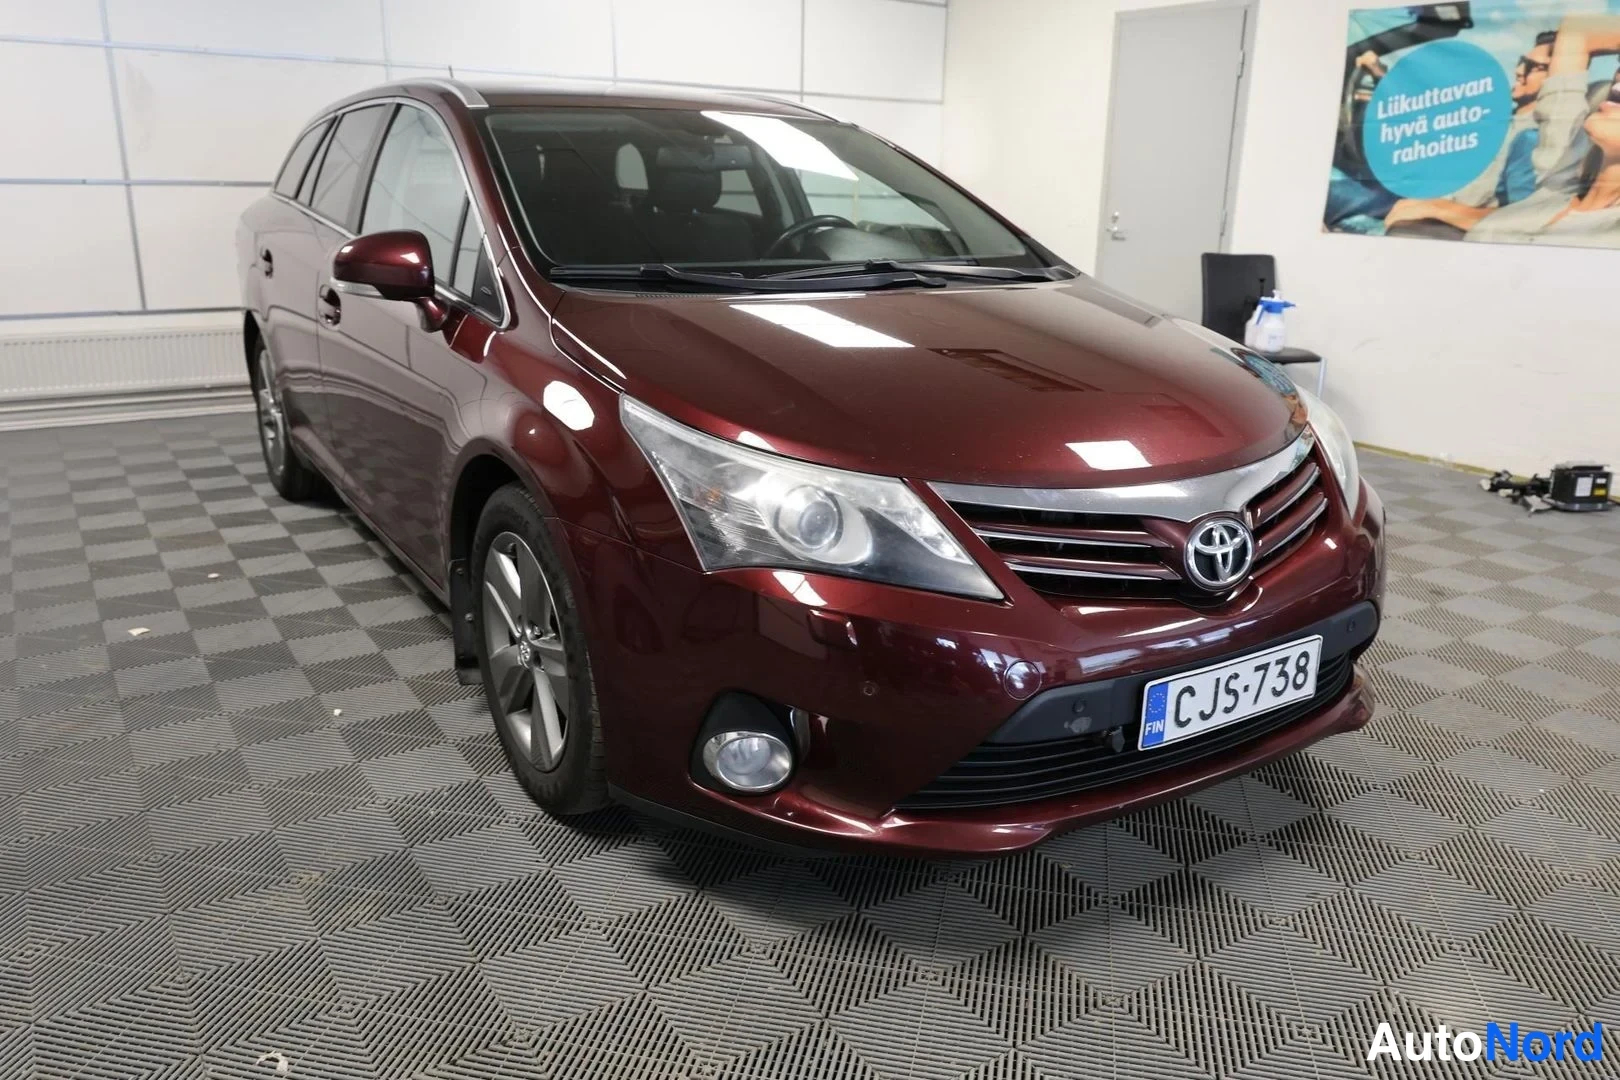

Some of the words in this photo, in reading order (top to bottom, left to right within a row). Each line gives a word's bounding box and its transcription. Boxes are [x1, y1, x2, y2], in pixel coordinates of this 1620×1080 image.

[1378, 77, 1493, 119] Liikuttavan
[1381, 116, 1427, 144] hyvä
[1434, 107, 1490, 130] auto-
[1393, 133, 1478, 164] rahoitus
[1174, 651, 1310, 728] CJS-738
[1145, 720, 1164, 735] FIN
